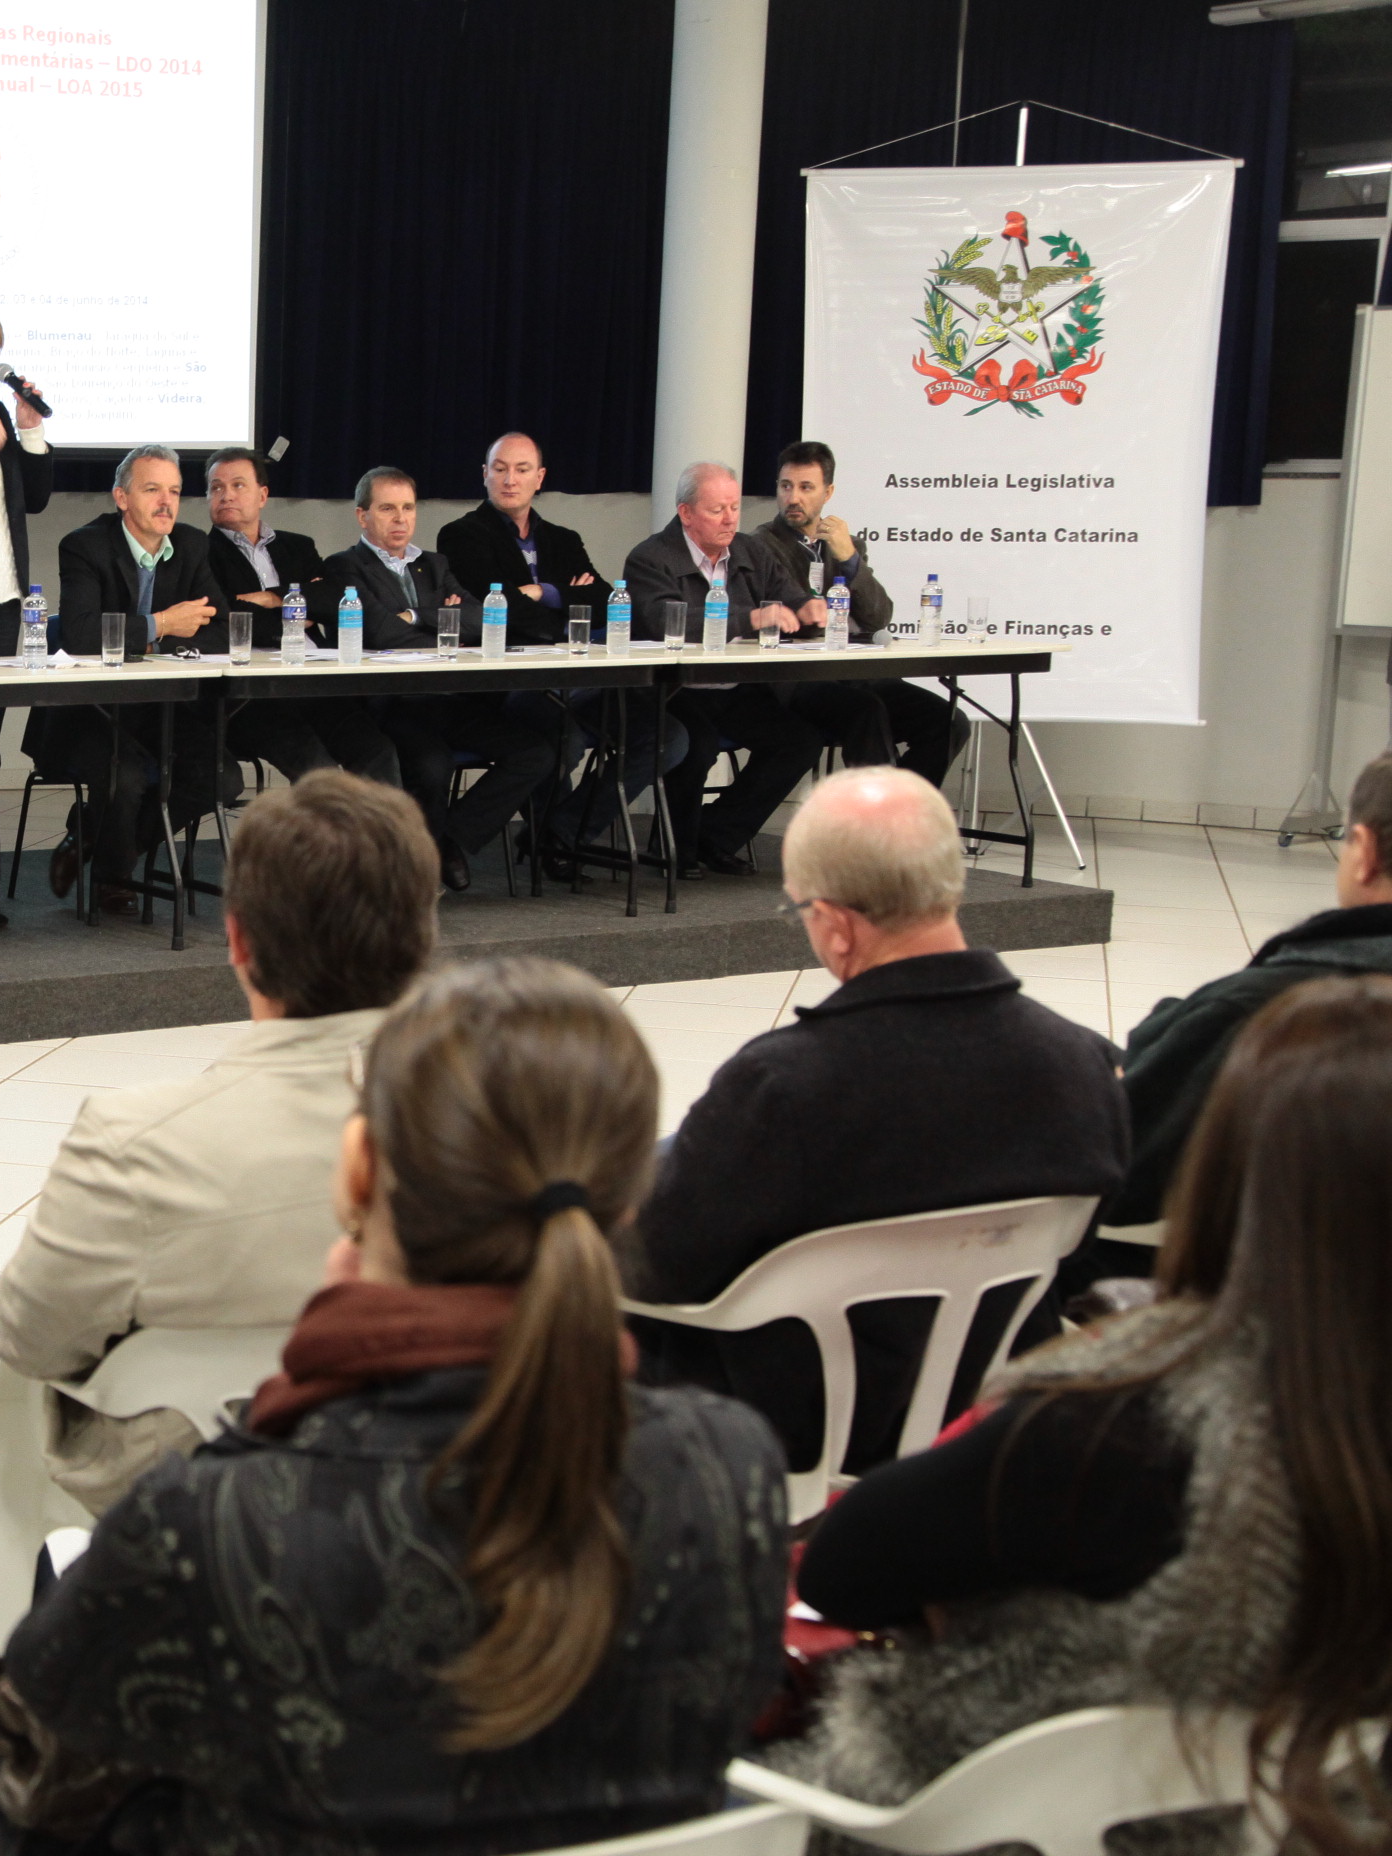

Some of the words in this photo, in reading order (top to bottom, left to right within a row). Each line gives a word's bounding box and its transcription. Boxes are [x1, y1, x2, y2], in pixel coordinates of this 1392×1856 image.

[22, 24, 113, 47] Regionais
[115, 55, 153, 73] LDO
[159, 58, 203, 76] 2014
[57, 78, 93, 95] LOA
[99, 80, 143, 98] 2015
[928, 381, 971, 394] ESTADO
[972, 388, 989, 399] DE
[1034, 380, 1083, 397] CATARINA
[885, 474, 998, 488] Assembleia
[1005, 474, 1115, 491] Legislativa
[857, 527, 880, 542] do
[887, 528, 953, 542] Estado
[960, 528, 984, 542] de
[990, 527, 1047, 542] Santa
[1054, 527, 1139, 542] Catarina
[1005, 621, 1093, 639] Finanças
[1100, 625, 1112, 635] e
